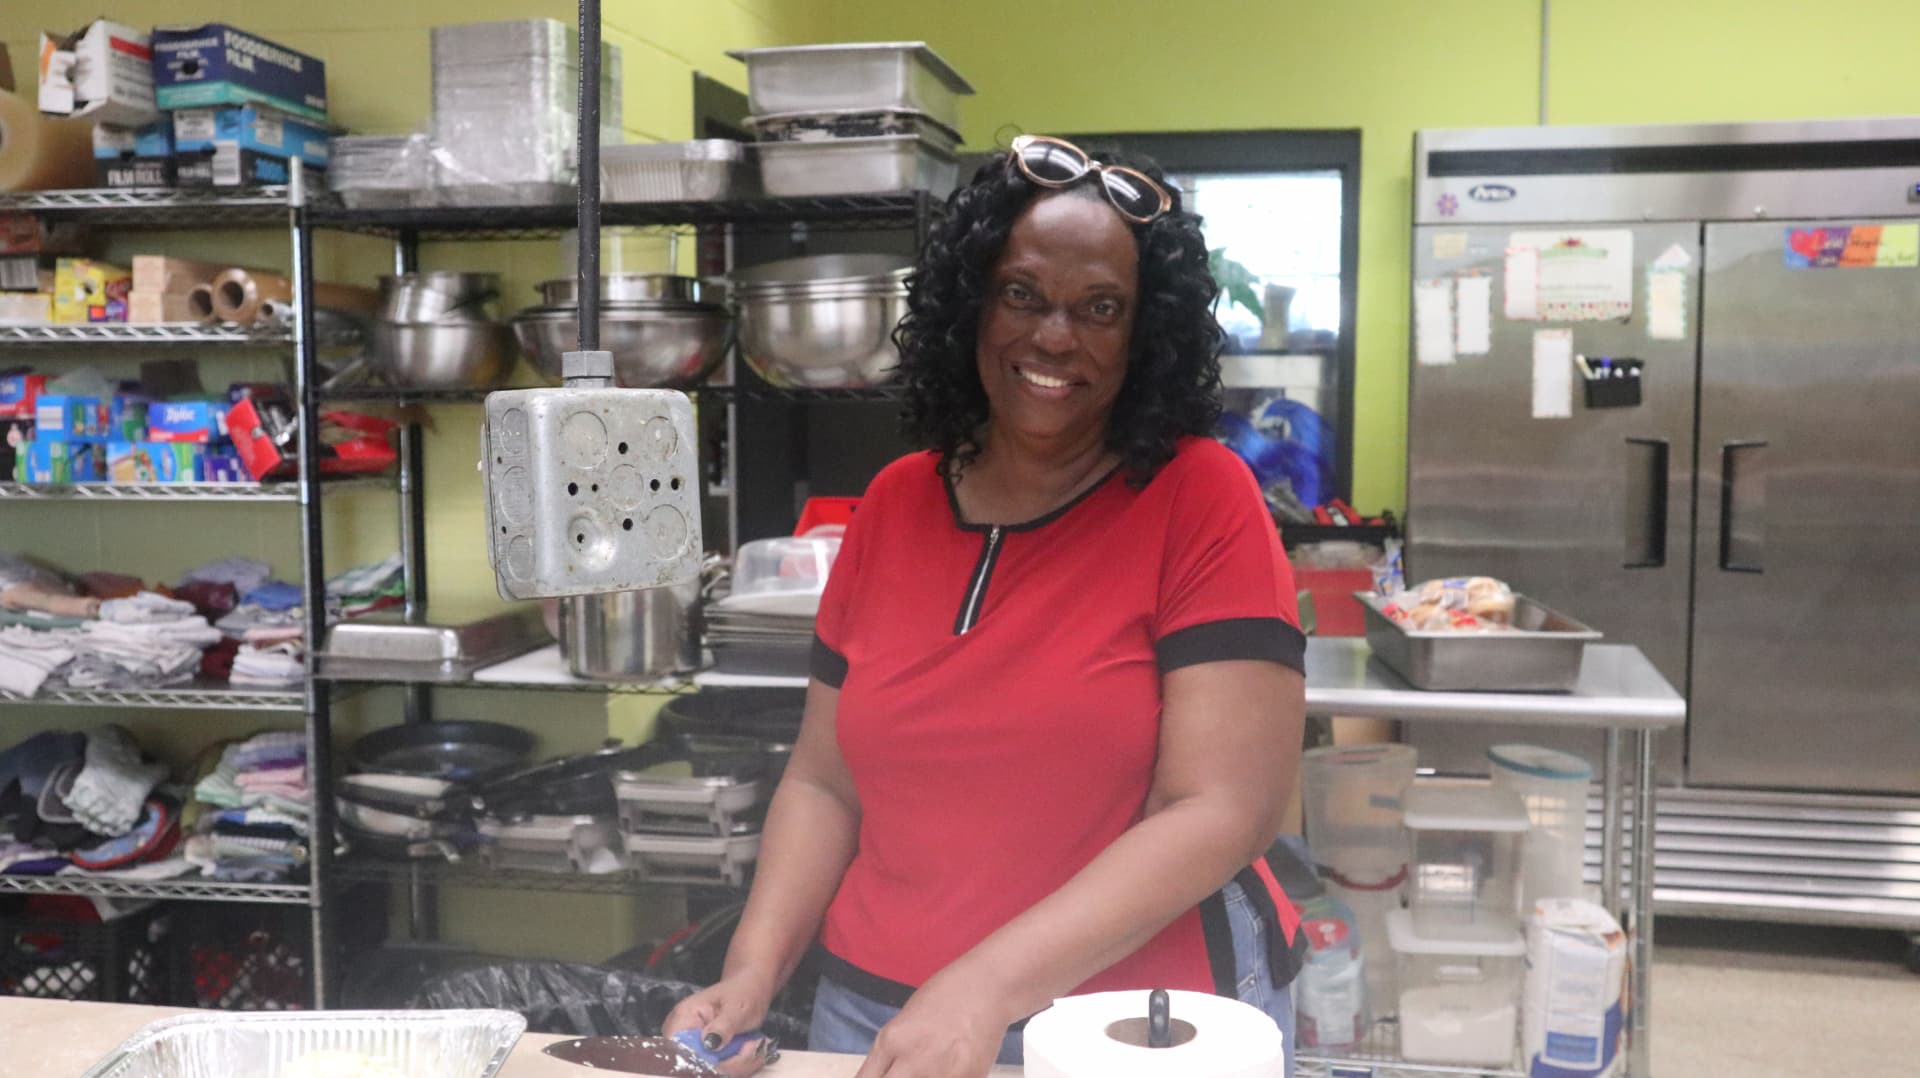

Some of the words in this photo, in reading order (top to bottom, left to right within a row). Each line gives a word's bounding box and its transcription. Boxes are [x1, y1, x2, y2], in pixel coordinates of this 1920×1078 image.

[224, 30, 302, 72] FOODSERVICE
[225, 48, 256, 73] FILM
[107, 168, 134, 187] FILM
